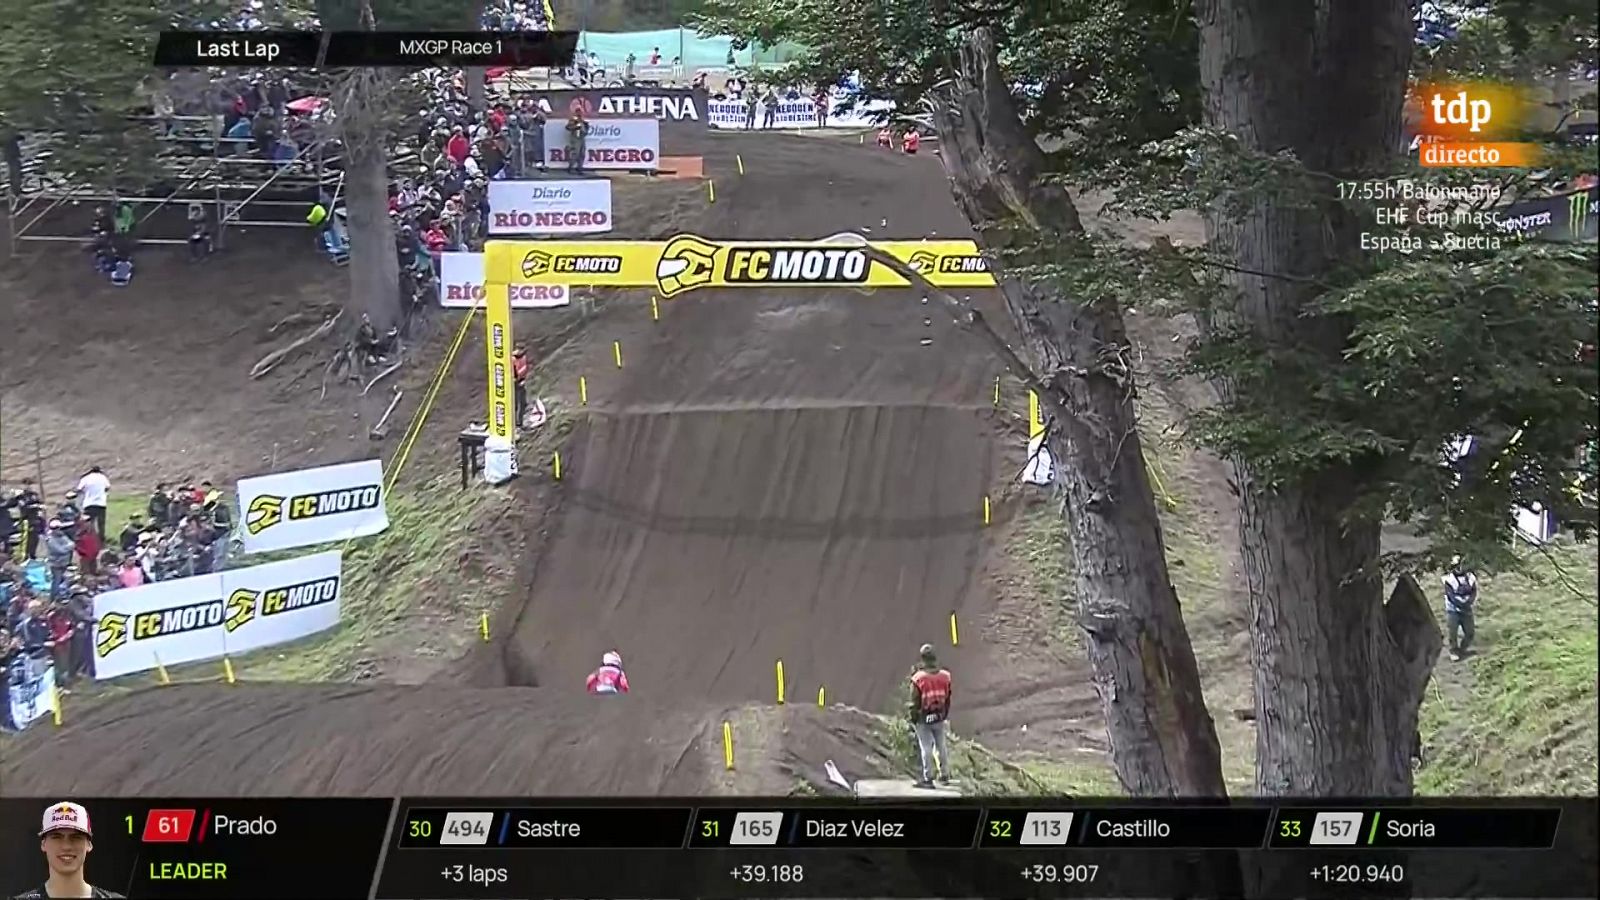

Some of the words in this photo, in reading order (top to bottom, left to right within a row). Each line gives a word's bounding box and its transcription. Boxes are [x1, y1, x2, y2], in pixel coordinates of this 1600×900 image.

[598, 96, 699, 120] ATHENA
[588, 149, 655, 162] NEGRO
[531, 187, 572, 200] Diario
[494, 210, 534, 227] RÍO
[535, 211, 607, 227] NEGRO
[509, 285, 565, 300] EGRO
